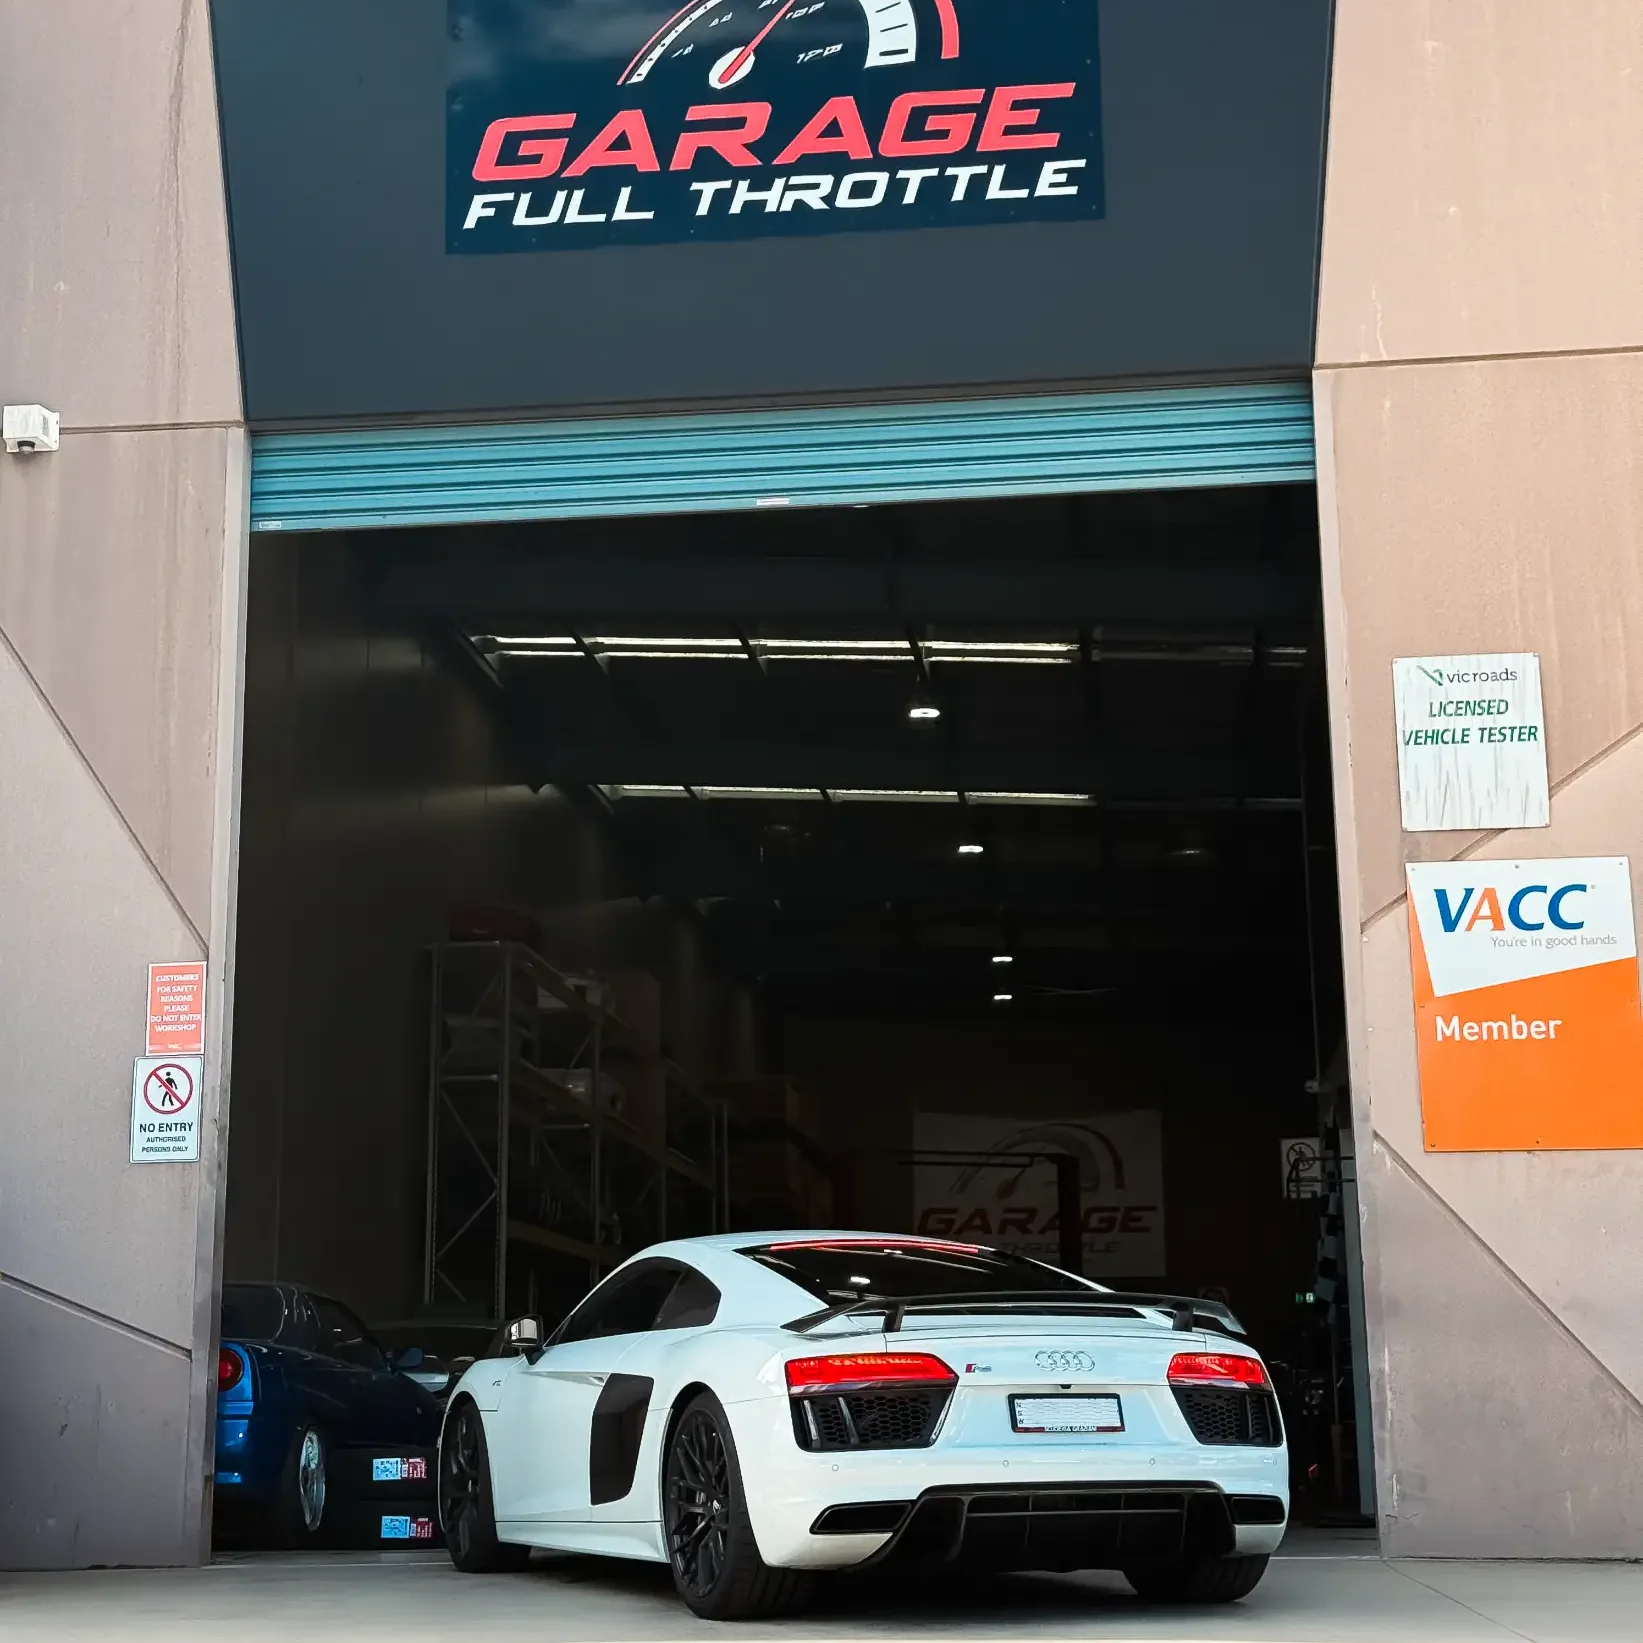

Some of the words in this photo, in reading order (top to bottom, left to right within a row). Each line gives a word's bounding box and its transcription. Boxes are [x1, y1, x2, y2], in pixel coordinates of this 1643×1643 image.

[471, 82, 1076, 182] GARAGE
[462, 186, 654, 229] FULL
[688, 158, 1087, 217] THROTTLE
[1446, 668, 1518, 684] vicroads
[1428, 699, 1509, 718] LICENSED
[1403, 727, 1471, 746] VEHICLE
[1478, 725, 1538, 743] TESTER
[1433, 884, 1587, 933] VACC
[1490, 936, 1528, 948] You're
[1530, 935, 1542, 947] in
[1545, 934, 1577, 949] good
[1580, 934, 1617, 946] hands
[156, 974, 199, 982] CUSTOMERS
[156, 985, 171, 993] FOR
[172, 984, 198, 992] SAFETY
[163, 1004, 190, 1012] PLEASE
[162, 1014, 179, 1022] NOT
[180, 1013, 201, 1021] ENTER
[154, 1023, 196, 1032] WORKSHOP
[1435, 1014, 1562, 1042] Member
[139, 1123, 156, 1133] NO
[158, 1121, 194, 1132] ENTRY
